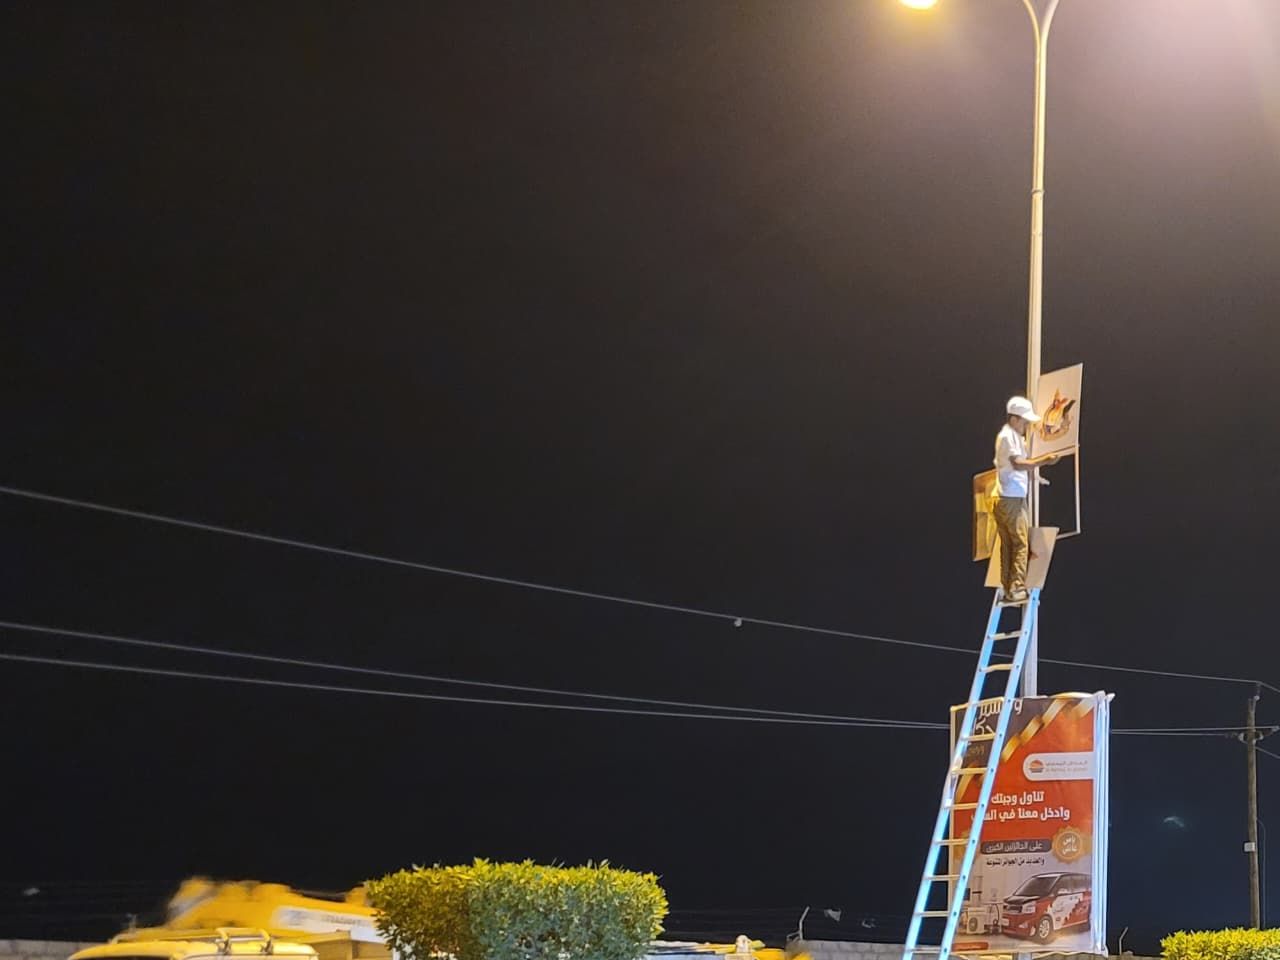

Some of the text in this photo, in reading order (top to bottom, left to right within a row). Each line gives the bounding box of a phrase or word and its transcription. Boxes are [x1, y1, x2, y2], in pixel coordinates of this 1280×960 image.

[991, 791, 1045, 806] تناول وجبتك
[999, 809, 1016, 822] في
[1018, 808, 1039, 819] معنا
[1040, 806, 1071, 821] وادخل
